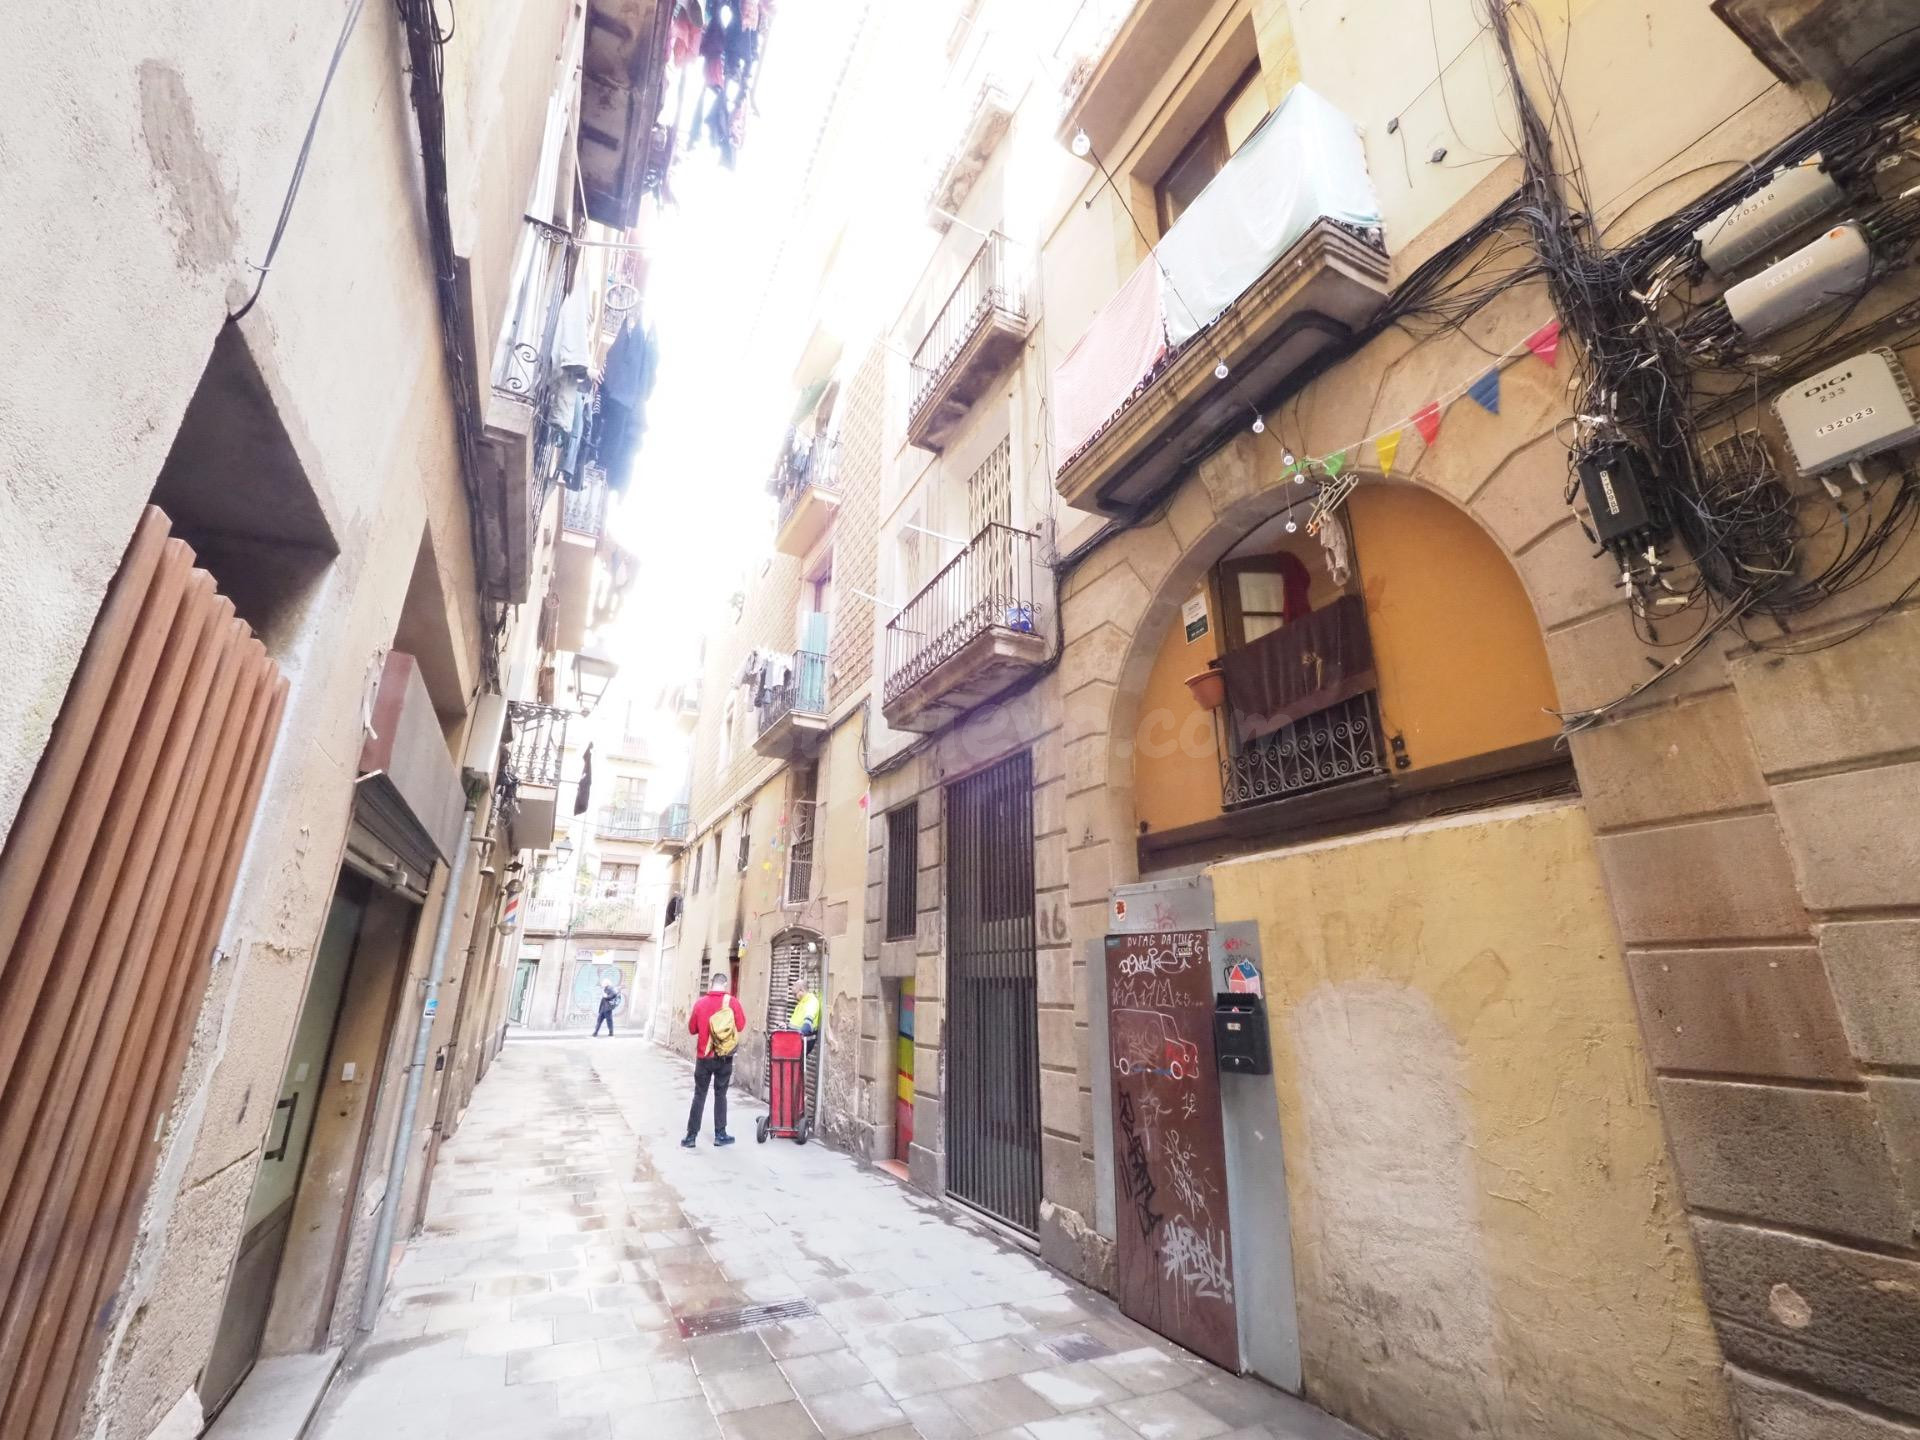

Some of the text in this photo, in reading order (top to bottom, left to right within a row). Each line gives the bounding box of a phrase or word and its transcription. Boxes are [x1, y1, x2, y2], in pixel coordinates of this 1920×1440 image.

[1805, 371, 1852, 397] DIGI
[1819, 387, 1846, 403] 233
[1817, 407, 1874, 435] 132023
